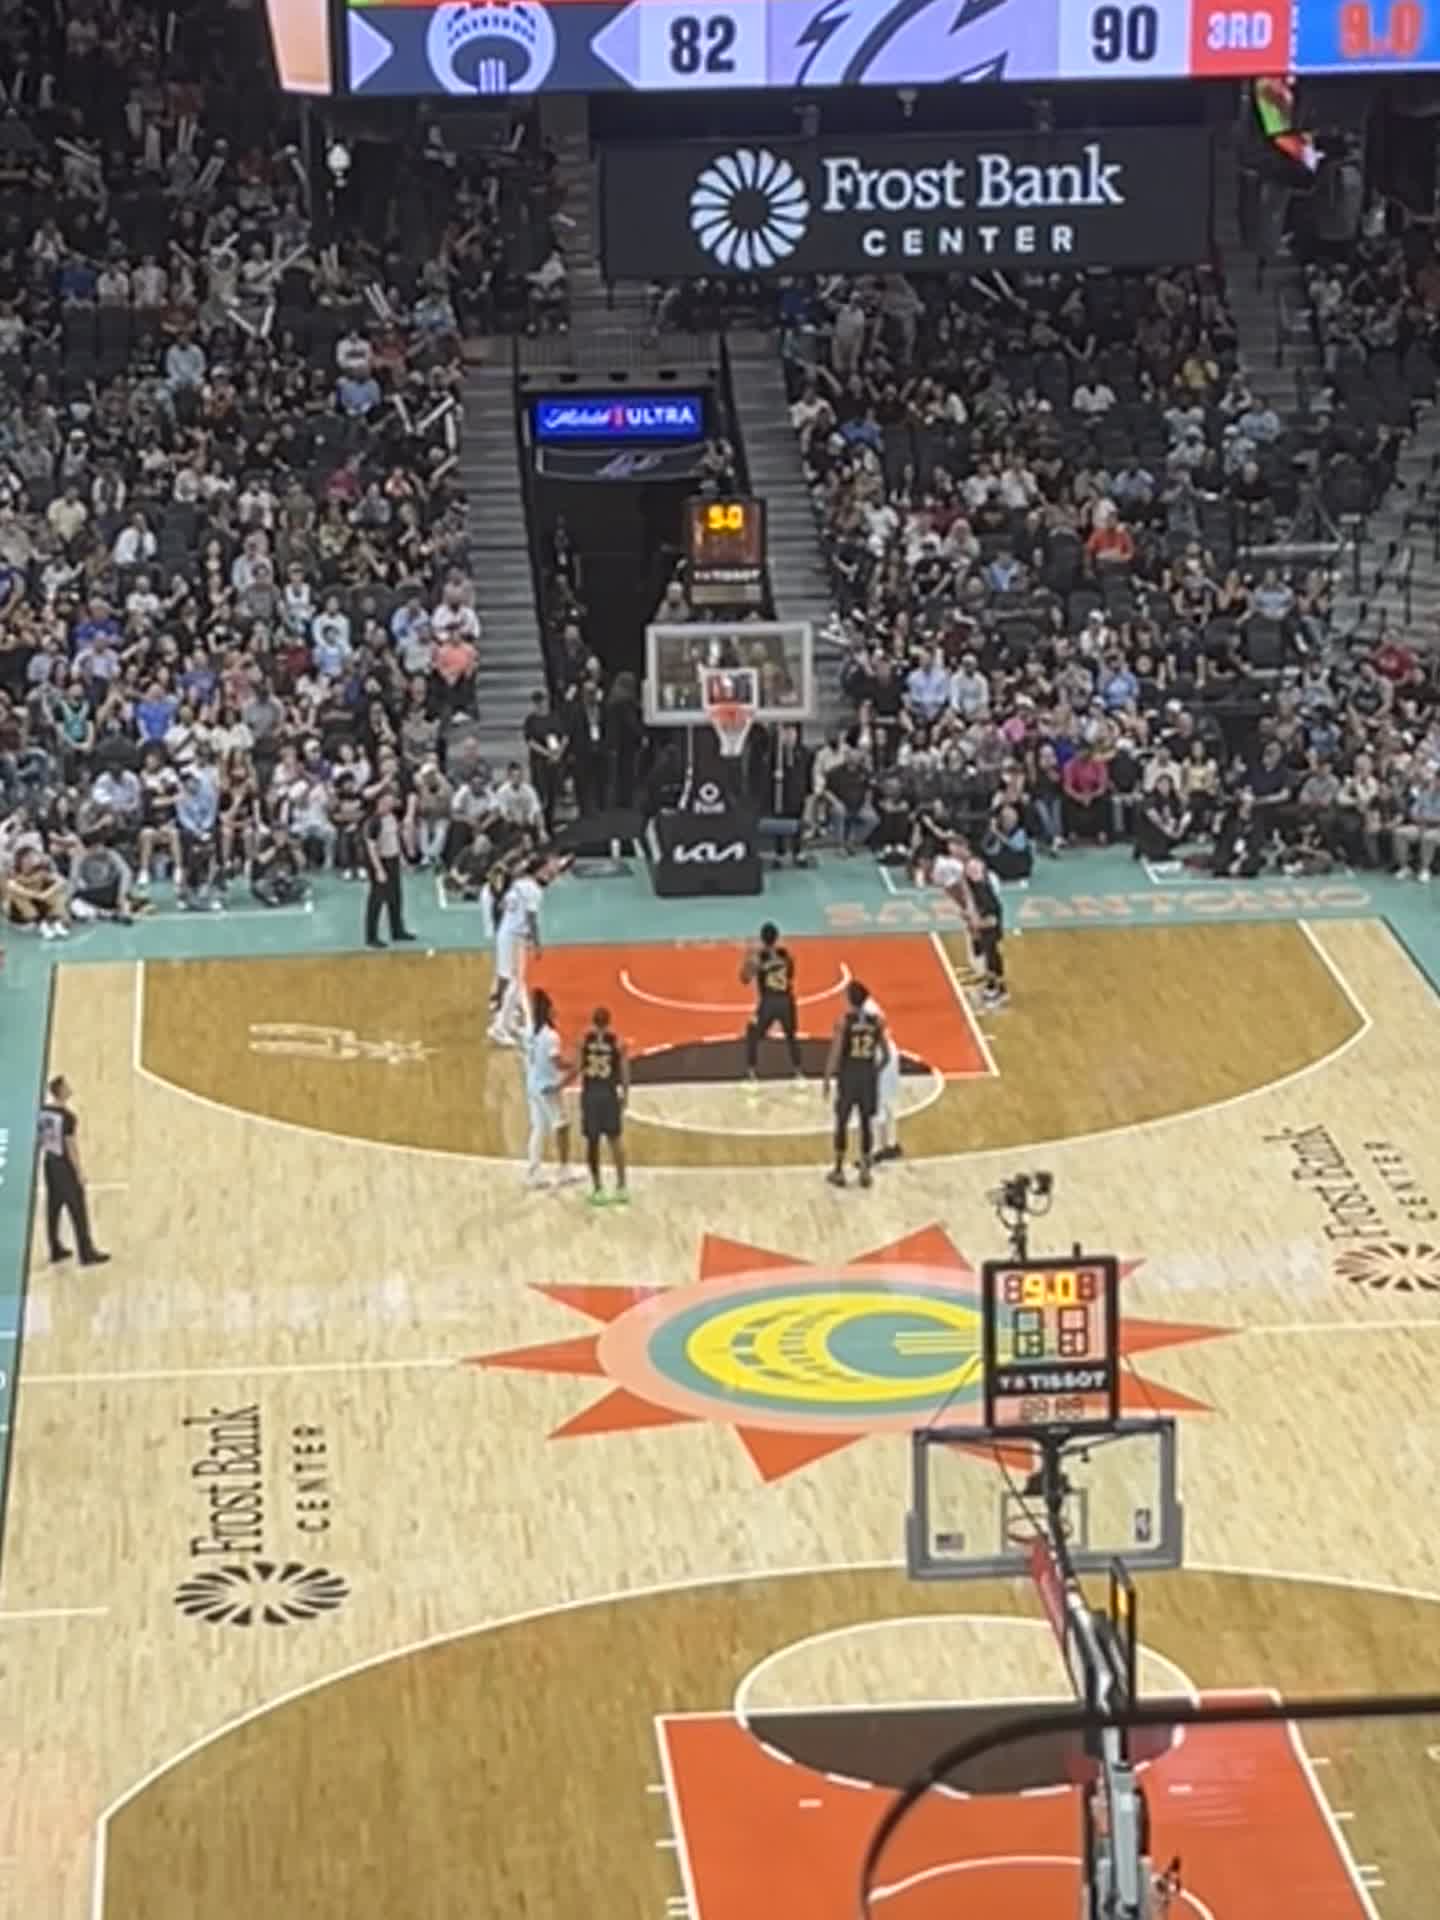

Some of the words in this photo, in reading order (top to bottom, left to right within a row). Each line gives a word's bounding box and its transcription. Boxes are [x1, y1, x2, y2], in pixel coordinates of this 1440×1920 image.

[670, 17, 736, 73] 82
[1092, 5, 1157, 61] 90
[1207, 11, 1272, 49] 3RD
[823, 157, 964, 210] Frost
[978, 144, 1123, 206] Bank
[863, 225, 1074, 256] CENTER
[627, 406, 695, 425] ULTRA
[850, 1035, 874, 1058] 12
[182, 1404, 262, 1479] Bank
[292, 1424, 331, 1533] CENTER
[190, 1482, 262, 1556] Frost
